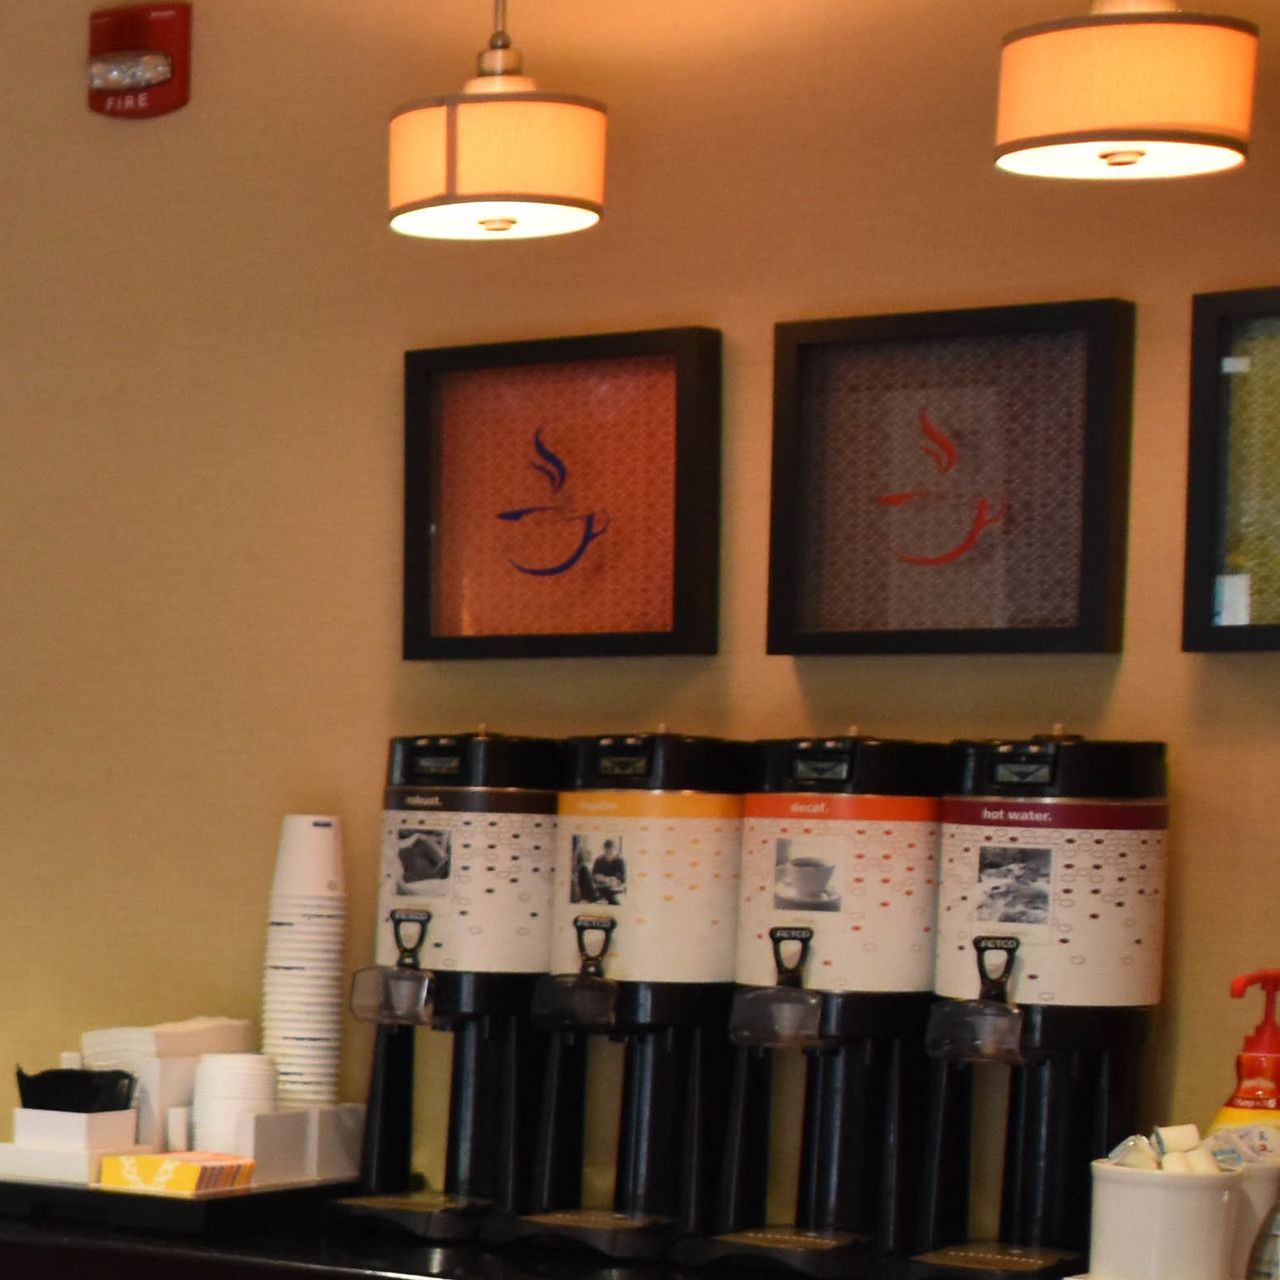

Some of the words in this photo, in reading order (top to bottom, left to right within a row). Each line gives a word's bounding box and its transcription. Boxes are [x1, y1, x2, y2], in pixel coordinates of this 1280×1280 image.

[104, 92, 149, 111] FIRE
[982, 808, 1005, 820] hot
[1007, 810, 1053, 822] water.
